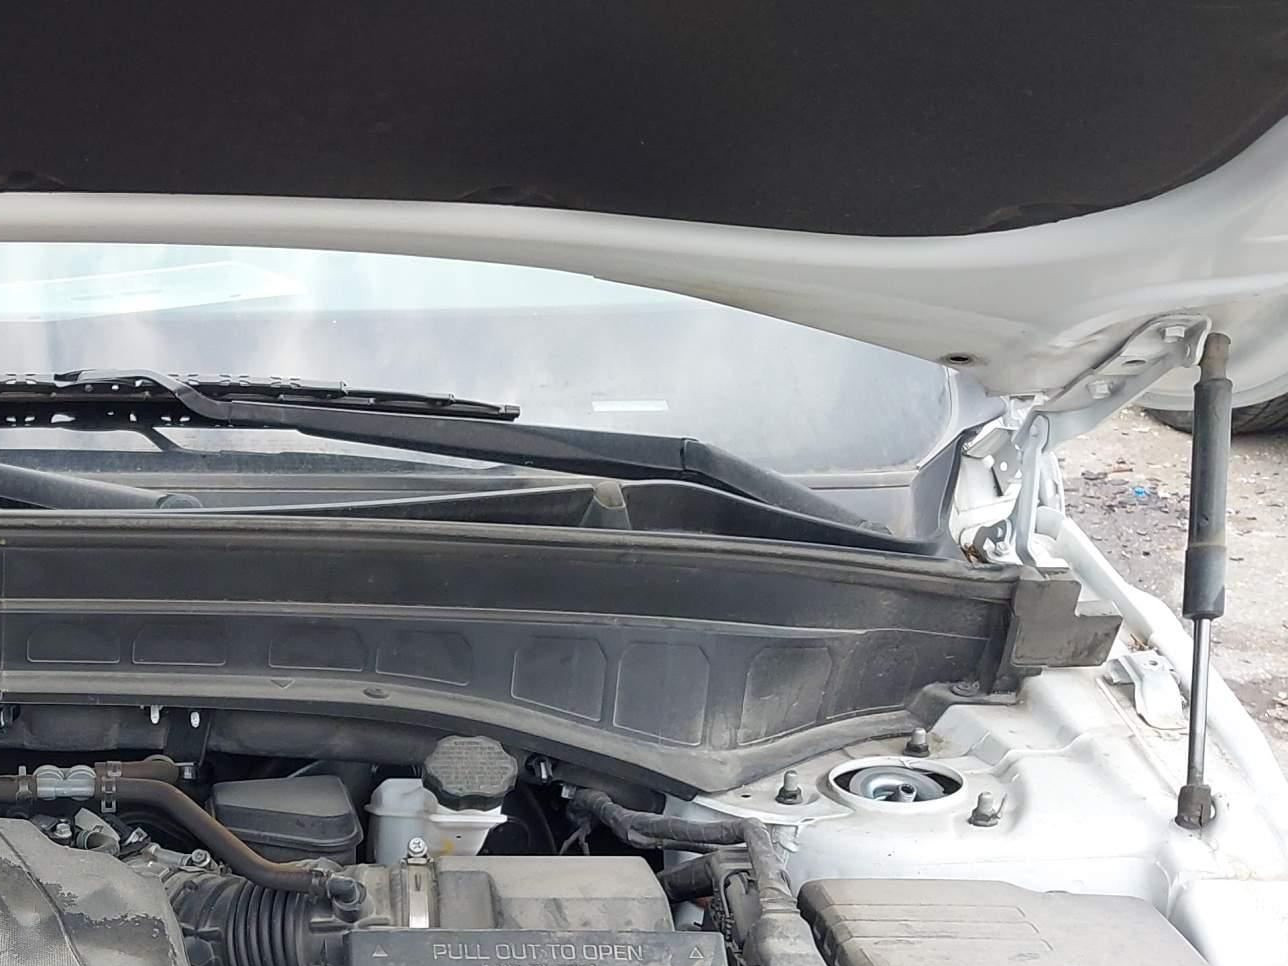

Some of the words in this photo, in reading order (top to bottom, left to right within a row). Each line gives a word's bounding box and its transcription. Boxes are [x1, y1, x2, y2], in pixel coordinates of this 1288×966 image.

[432, 943, 490, 961] PULL
[495, 943, 538, 961] OUT
[549, 944, 576, 961] TO
[581, 944, 644, 962] OPEN
